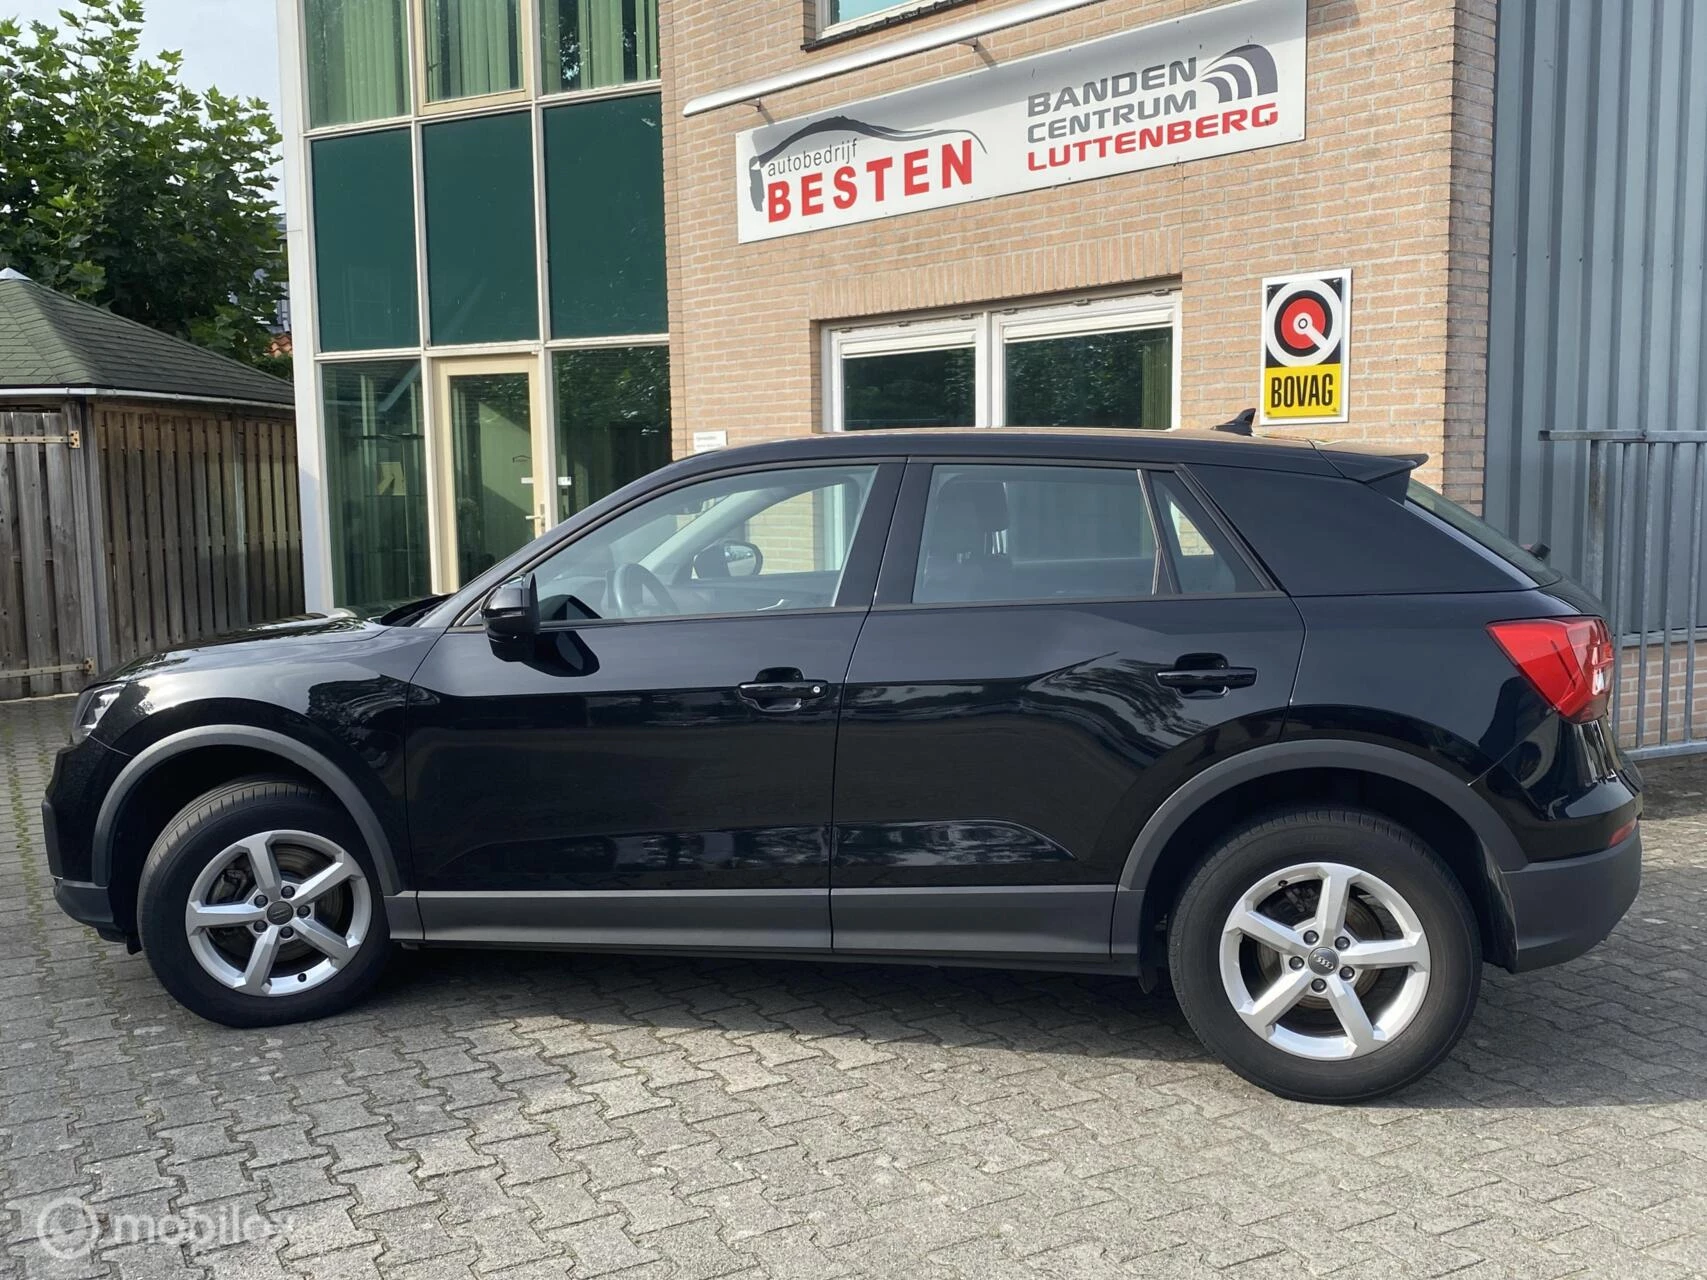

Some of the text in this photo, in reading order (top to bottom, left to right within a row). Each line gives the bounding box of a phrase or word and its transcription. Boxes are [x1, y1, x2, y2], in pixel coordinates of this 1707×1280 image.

[1027, 56, 1197, 118] BANDEN
[1027, 89, 1197, 144] CENTRUM
[1027, 102, 1279, 172] LUTTENBERG
[767, 139, 973, 223] BESTEN
[768, 138, 858, 177] autobedrijf
[1270, 373, 1334, 408] BOVAG
